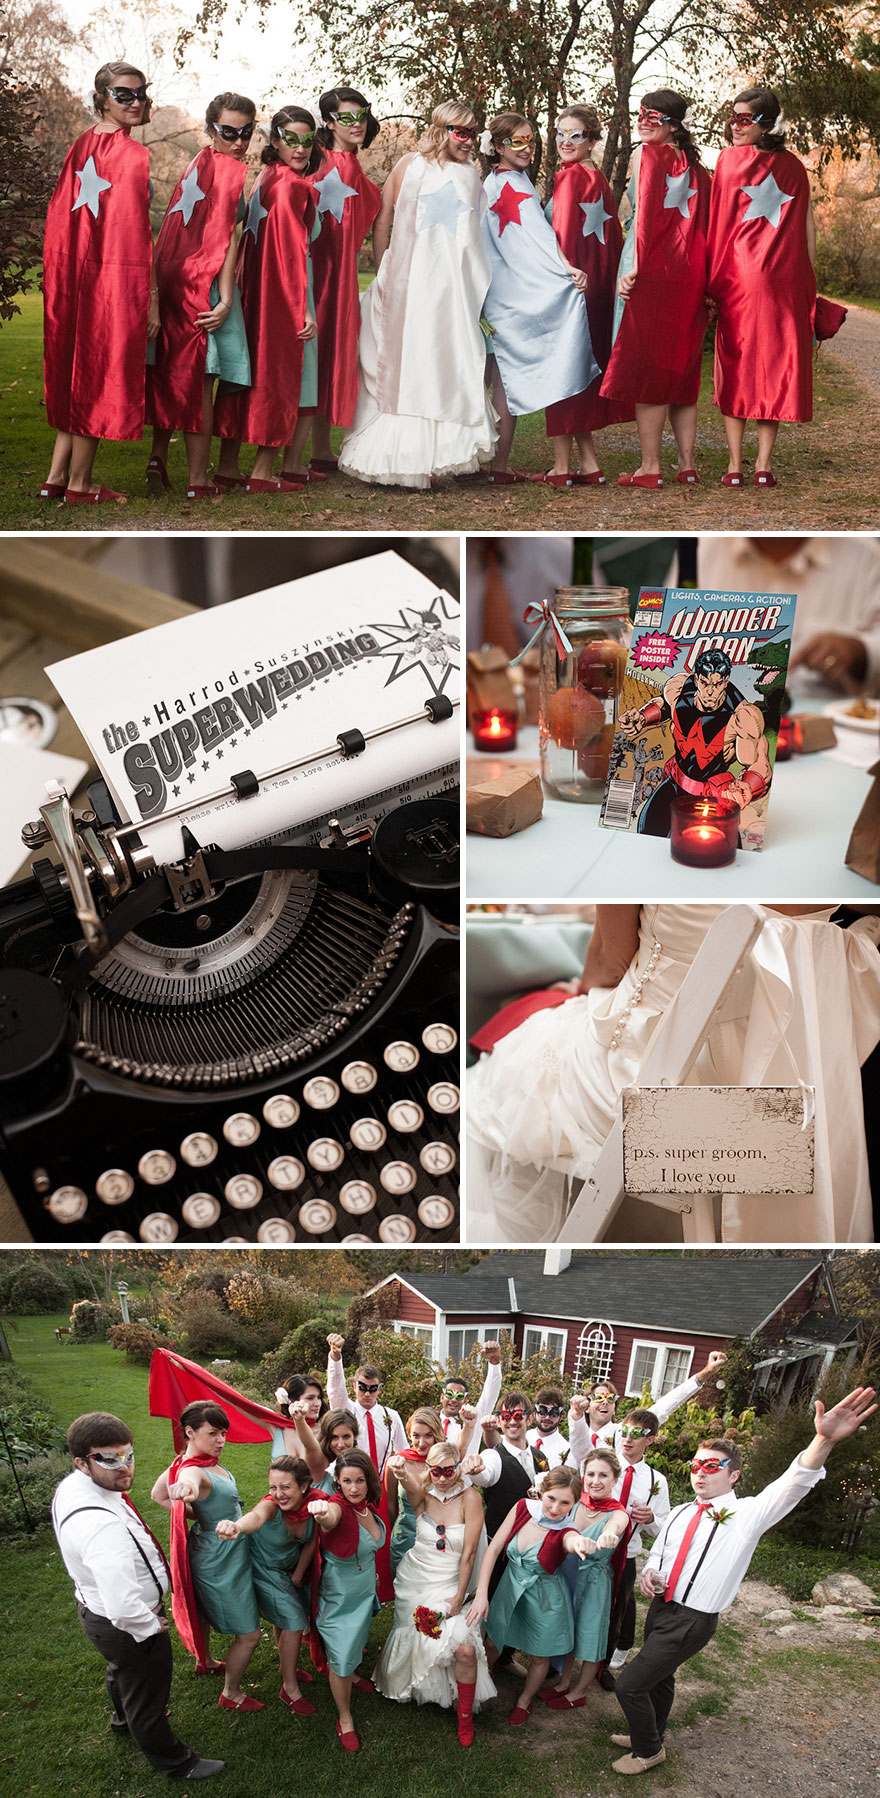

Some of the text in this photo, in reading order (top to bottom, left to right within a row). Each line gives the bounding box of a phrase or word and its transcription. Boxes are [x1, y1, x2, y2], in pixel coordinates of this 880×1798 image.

[671, 592, 702, 602] LIGHTS,
[703, 593, 746, 603] CAMERAS
[756, 595, 791, 605] ACTION!
[667, 605, 783, 640] WONDER
[648, 638, 666, 647] FREE
[639, 655, 670, 664] INSIDE!
[640, 647, 671, 656] POSTER
[684, 636, 756, 673] MAN
[153, 627, 354, 724] Harrod Suszynski
[102, 720, 141, 754] the
[180, 809, 211, 825] Please
[214, 798, 241, 812] write
[272, 778, 290, 789] Tom
[301, 766, 322, 778] love
[436, 1092, 453, 1108] O
[358, 1127, 376, 1143] U
[316, 1147, 331, 1164] Y
[428, 1150, 445, 1167] K
[634, 1147, 659, 1161] p.s.
[664, 1148, 707, 1161] super
[279, 1166, 292, 1182] T
[394, 1170, 405, 1187] J
[661, 1168, 736, 1185] I love you
[235, 1184, 249, 1201] R
[347, 1189, 367, 1206] H
[193, 1201, 208, 1219] E
[307, 1210, 326, 1226] G
[148, 1223, 168, 1239] W
[389, 1222, 407, 1239] N
